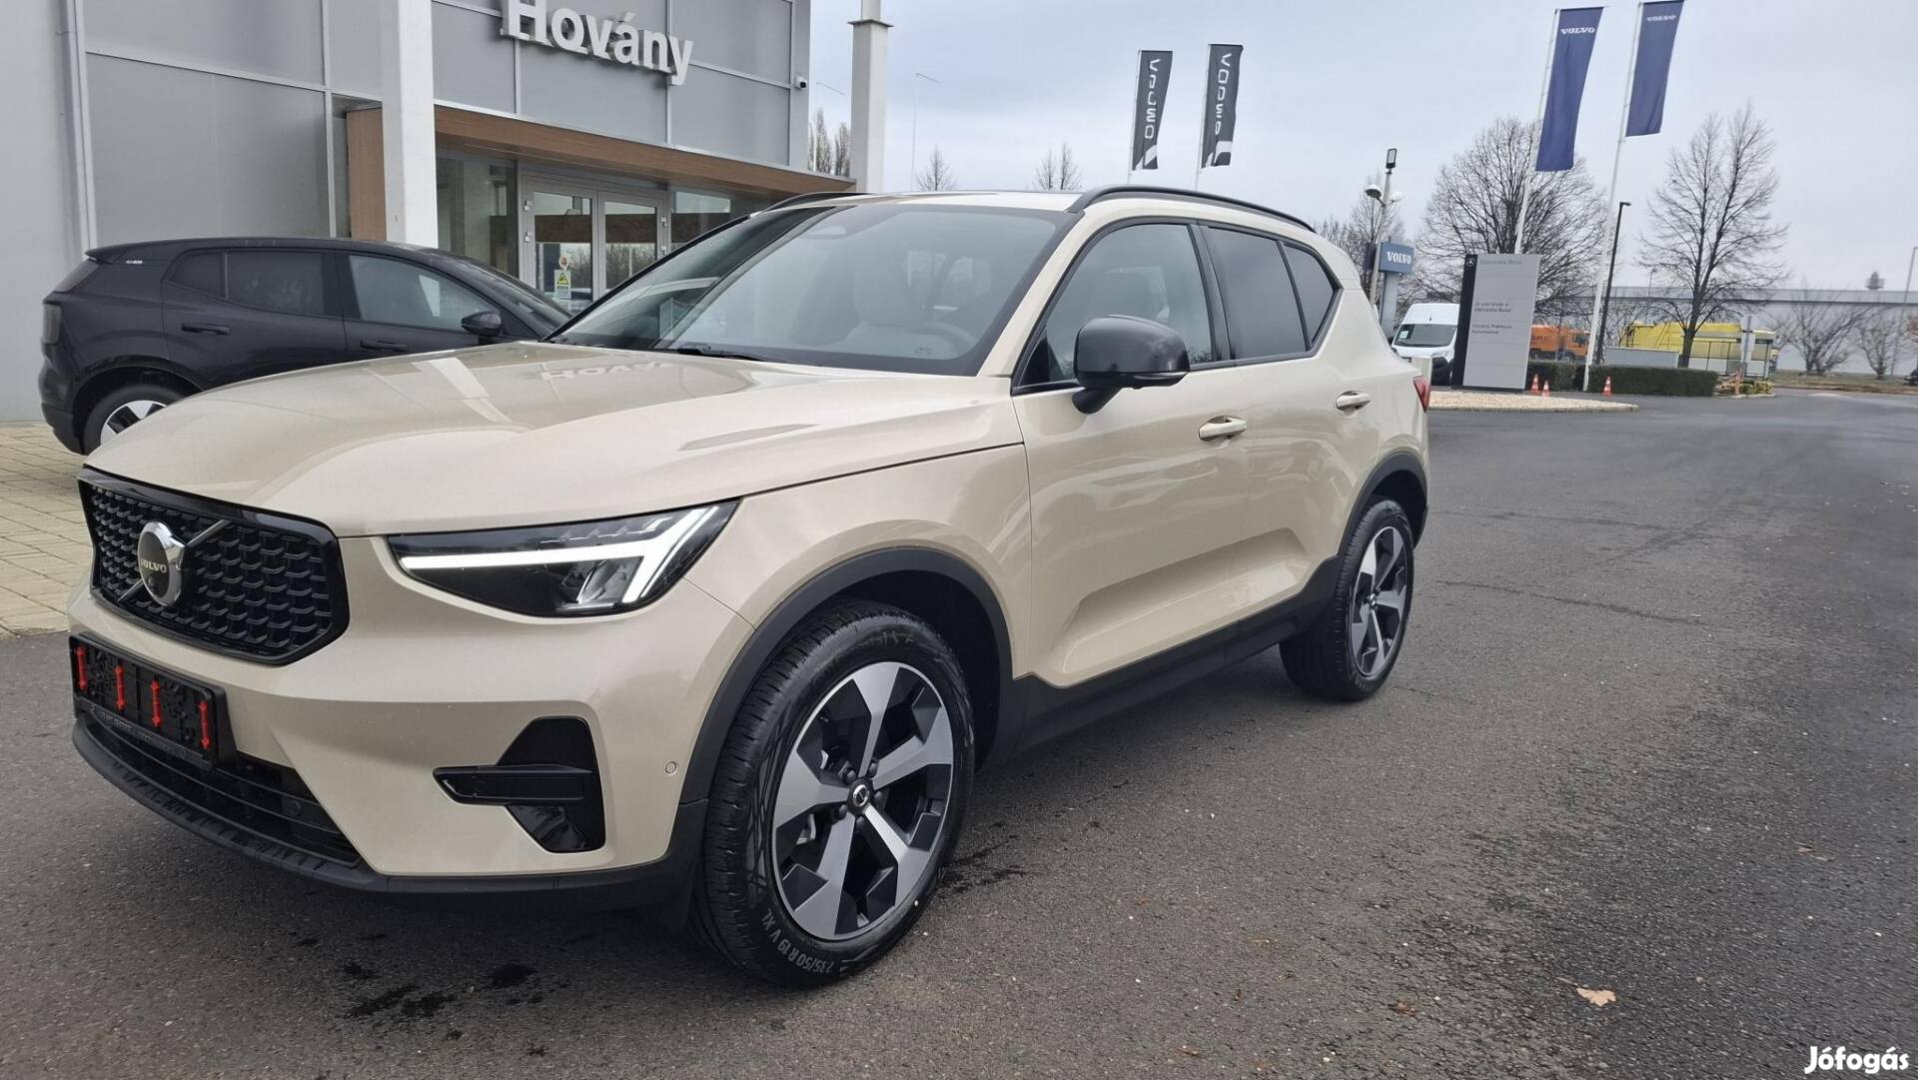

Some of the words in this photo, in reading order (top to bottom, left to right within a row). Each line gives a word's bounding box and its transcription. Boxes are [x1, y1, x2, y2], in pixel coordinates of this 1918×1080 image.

[1560, 27, 1596, 35] VOLVO
[507, 0, 694, 86] Hovány
[1387, 251, 1412, 265] VOLVO
[761, 907, 776, 931] XL
[769, 928, 782, 943] V
